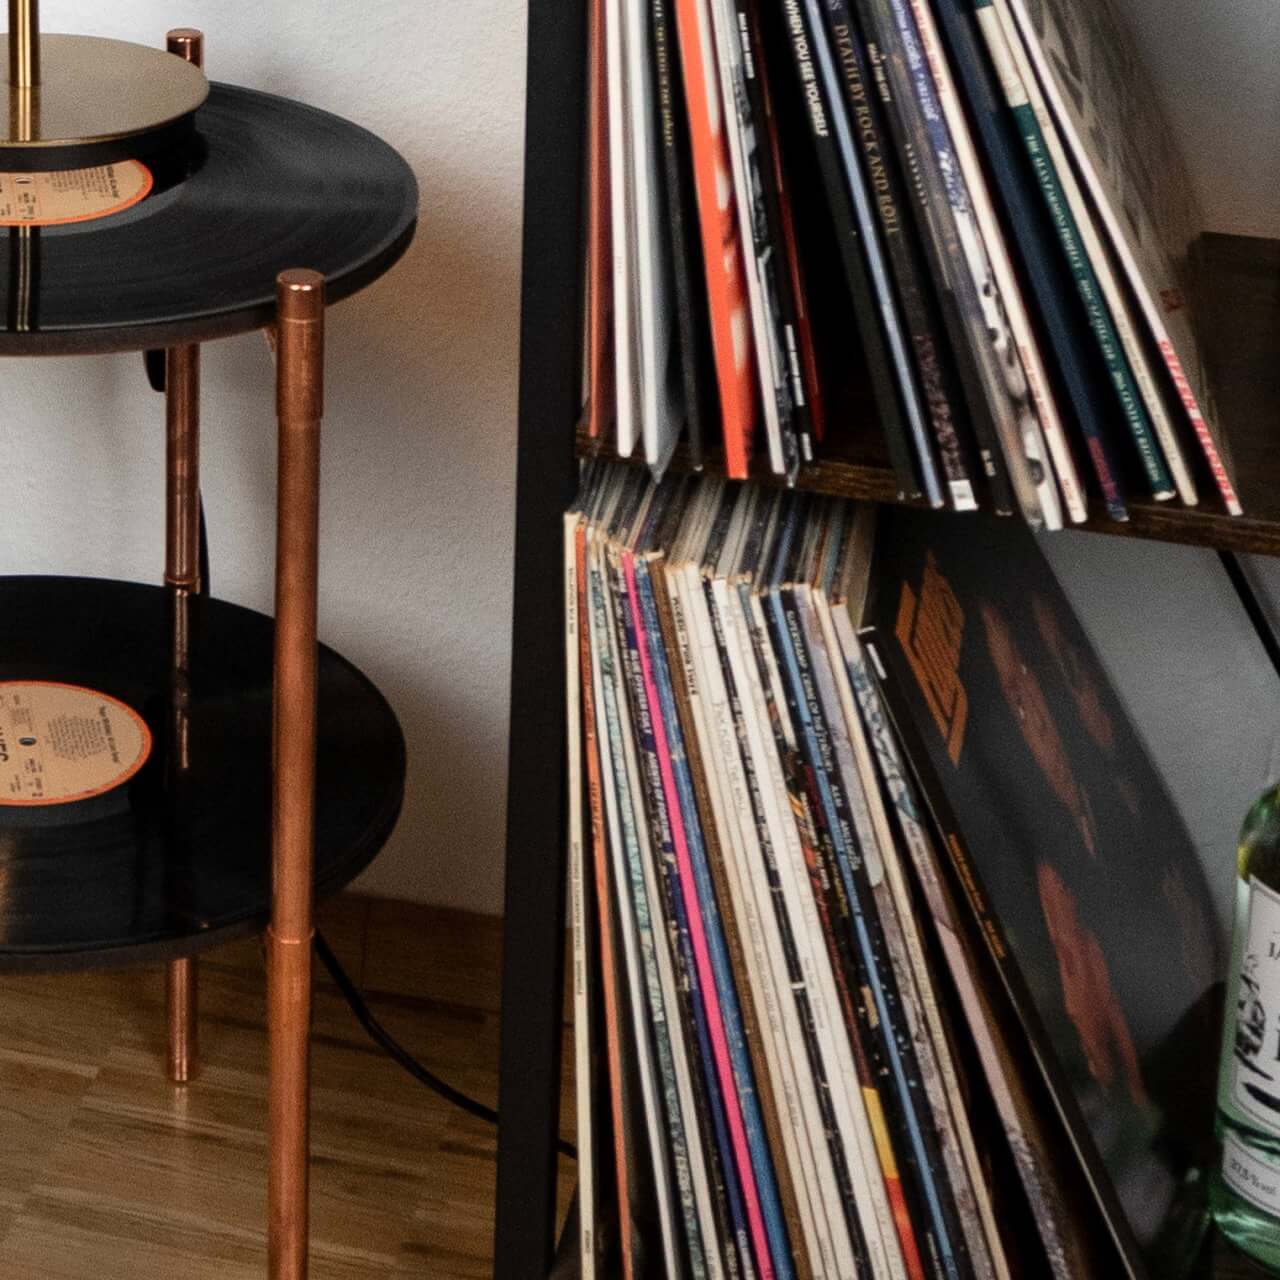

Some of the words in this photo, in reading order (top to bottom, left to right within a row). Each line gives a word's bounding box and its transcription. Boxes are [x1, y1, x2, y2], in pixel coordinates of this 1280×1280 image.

[792, 34, 810, 61] YOU
[832, 21, 861, 80] DEATH
[798, 60, 815, 82] SEE
[803, 80, 829, 138] YOURSELF
[848, 81, 866, 103] BY
[853, 103, 879, 153] ROCK
[866, 152, 889, 192] AND
[876, 192, 901, 235] ROLL
